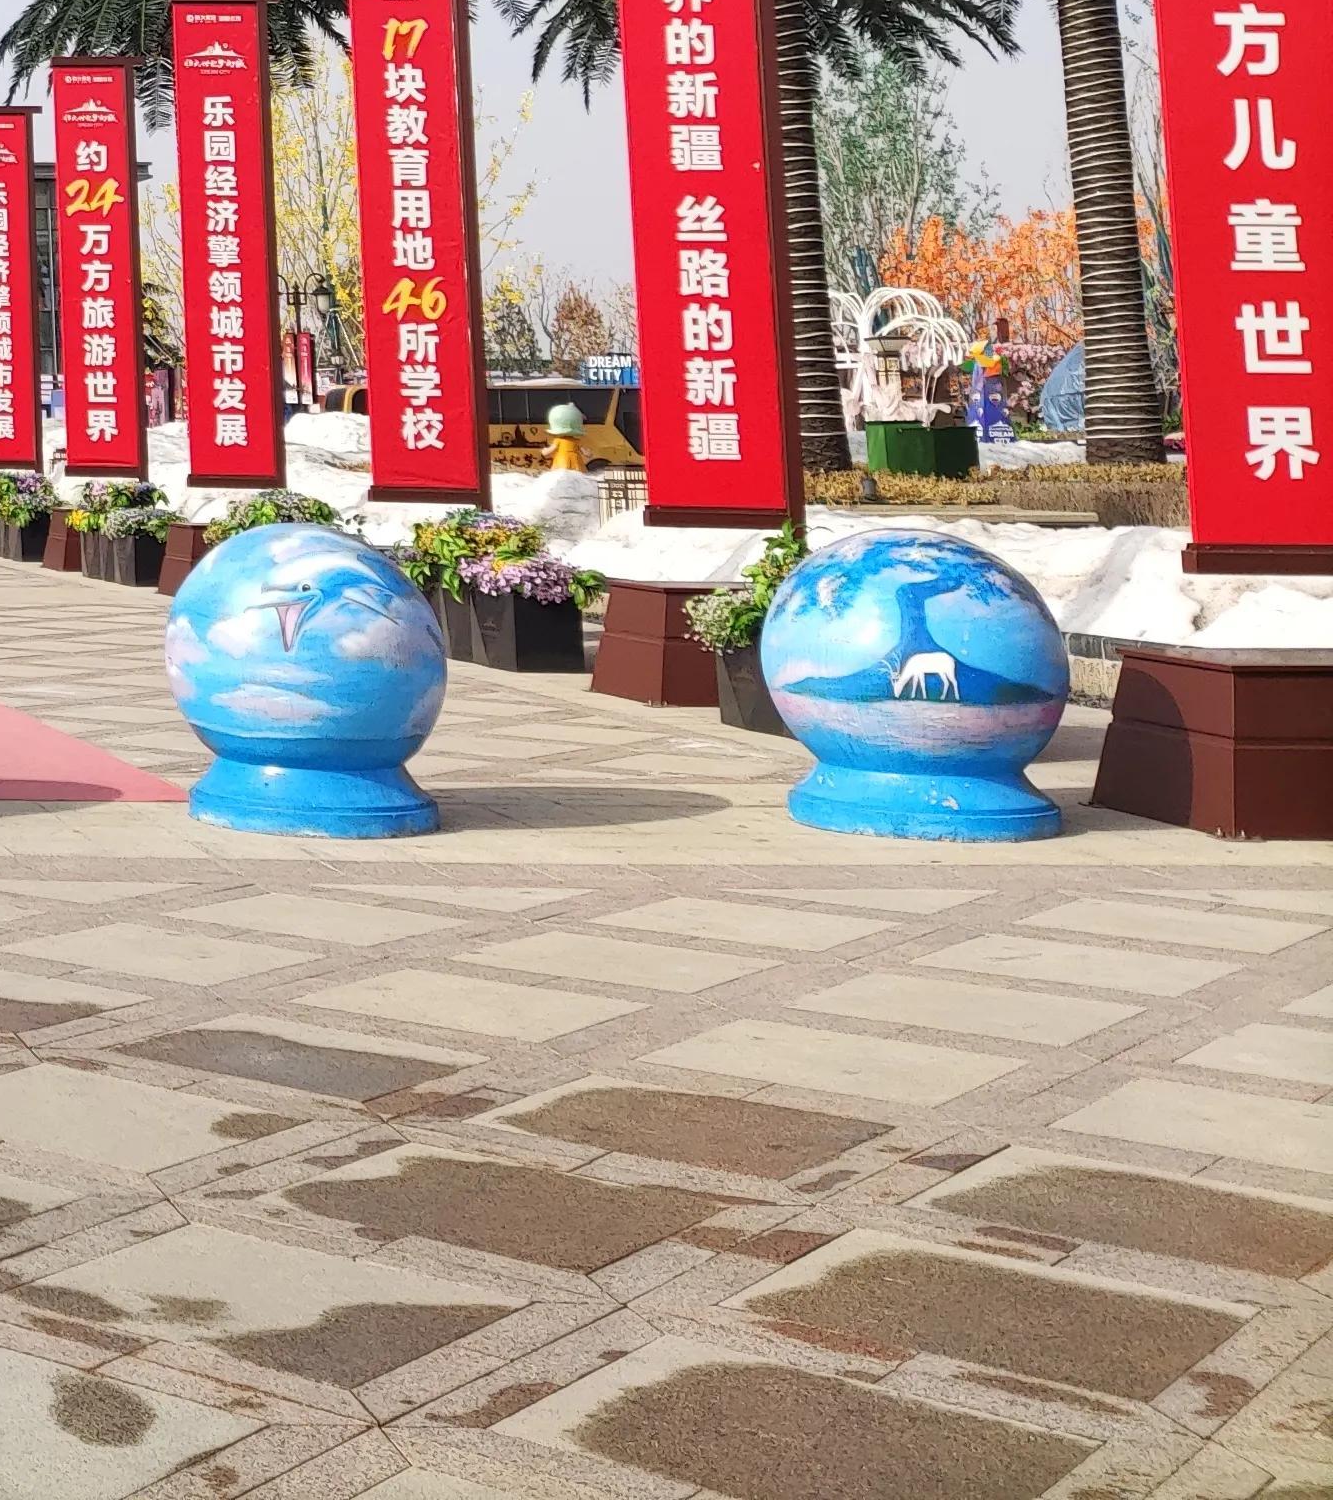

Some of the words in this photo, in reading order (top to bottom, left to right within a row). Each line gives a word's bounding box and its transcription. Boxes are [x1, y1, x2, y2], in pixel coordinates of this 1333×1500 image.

[65, 141, 124, 443] 约24万方旅游世界
[203, 96, 247, 446] 乐园经济擎领城市发展
[383, 19, 446, 449] 17块教育用地46所学校
[589, 355, 631, 368] DREAM
[589, 368, 622, 381] CITY
[676, 196, 741, 460] 丝路的新疆
